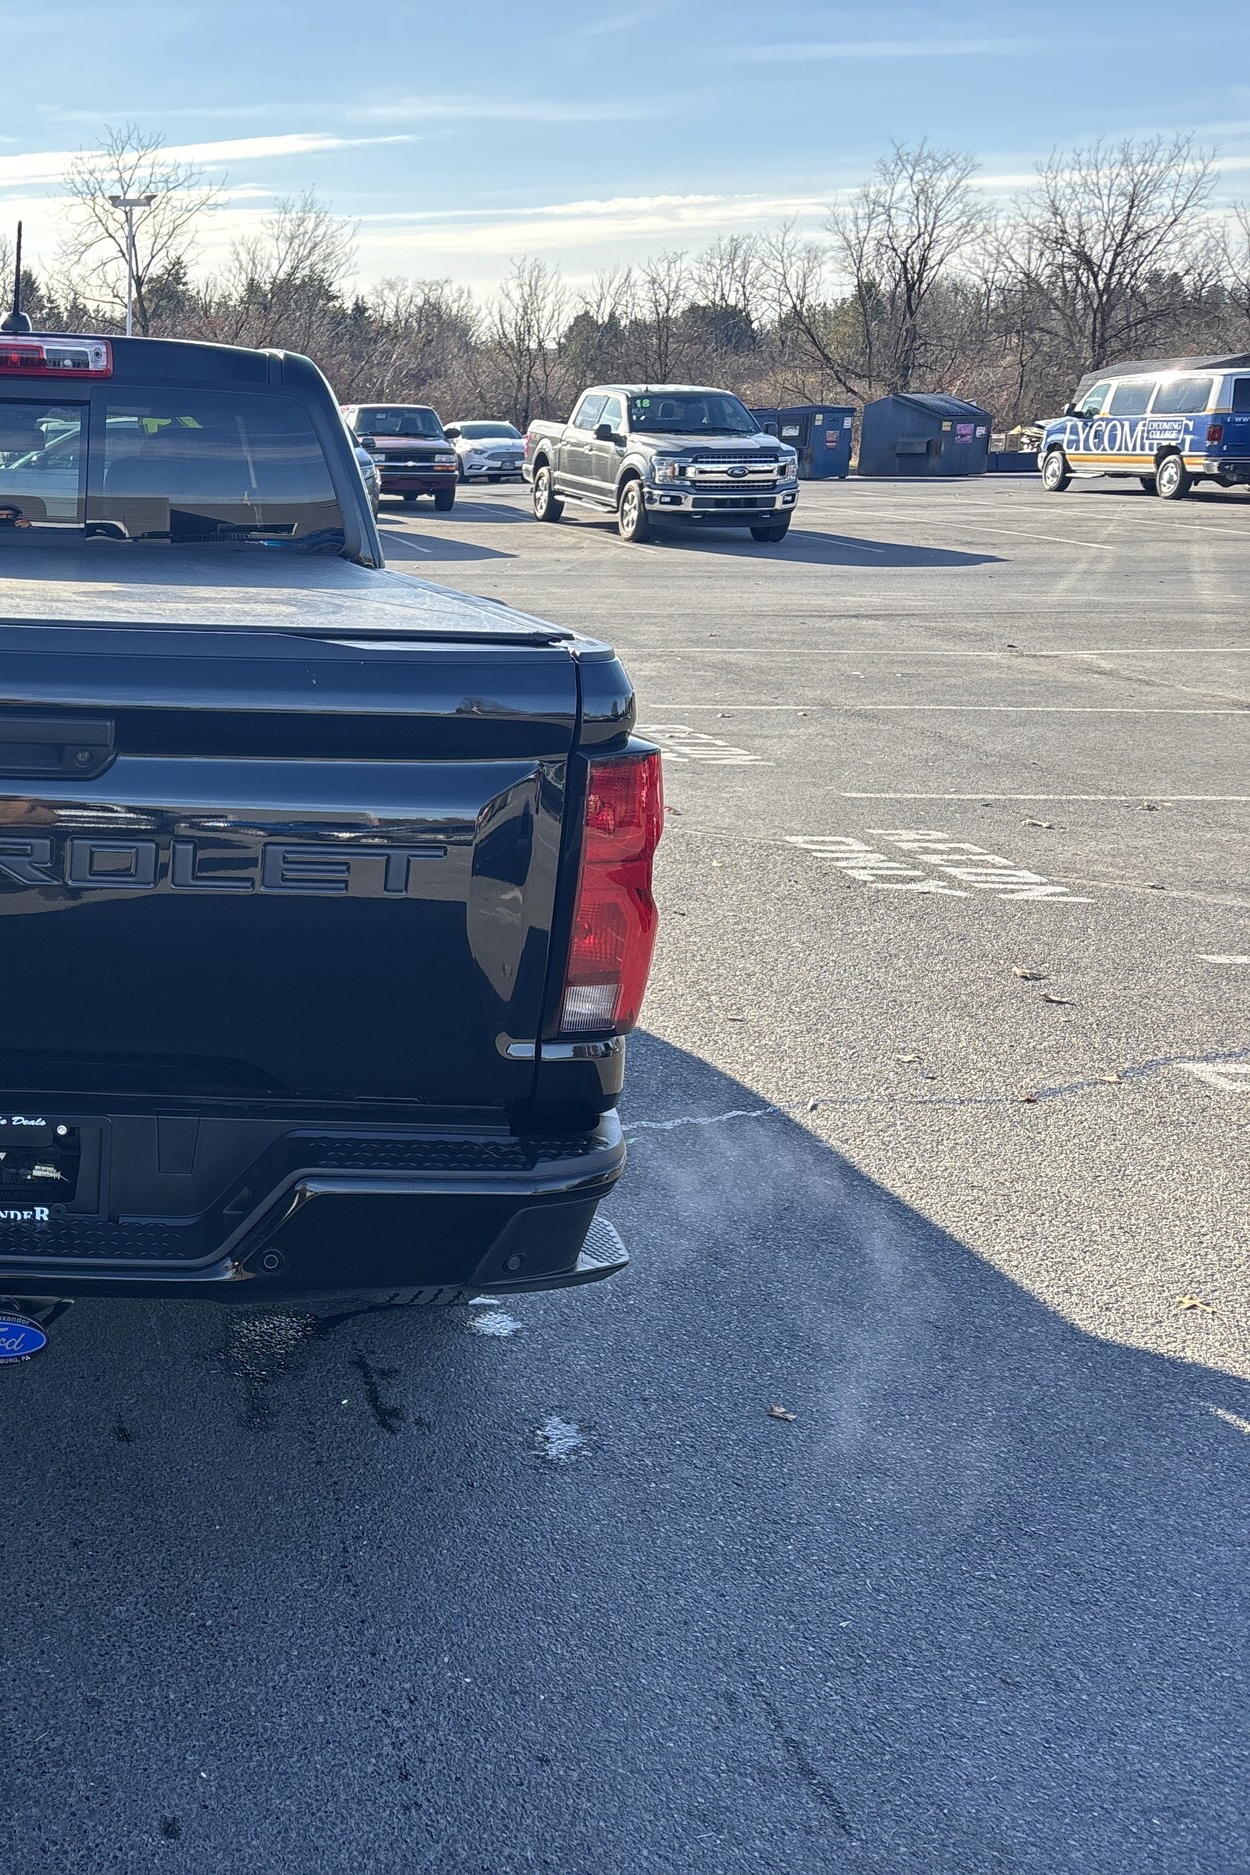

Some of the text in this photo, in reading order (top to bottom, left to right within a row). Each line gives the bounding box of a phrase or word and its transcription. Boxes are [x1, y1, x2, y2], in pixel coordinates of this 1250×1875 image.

[635, 398, 651, 408] 18
[1149, 421, 1182, 430] LYCOMING
[1149, 430, 1178, 439] COLLEGE
[11, 1116, 47, 1126] Deals
